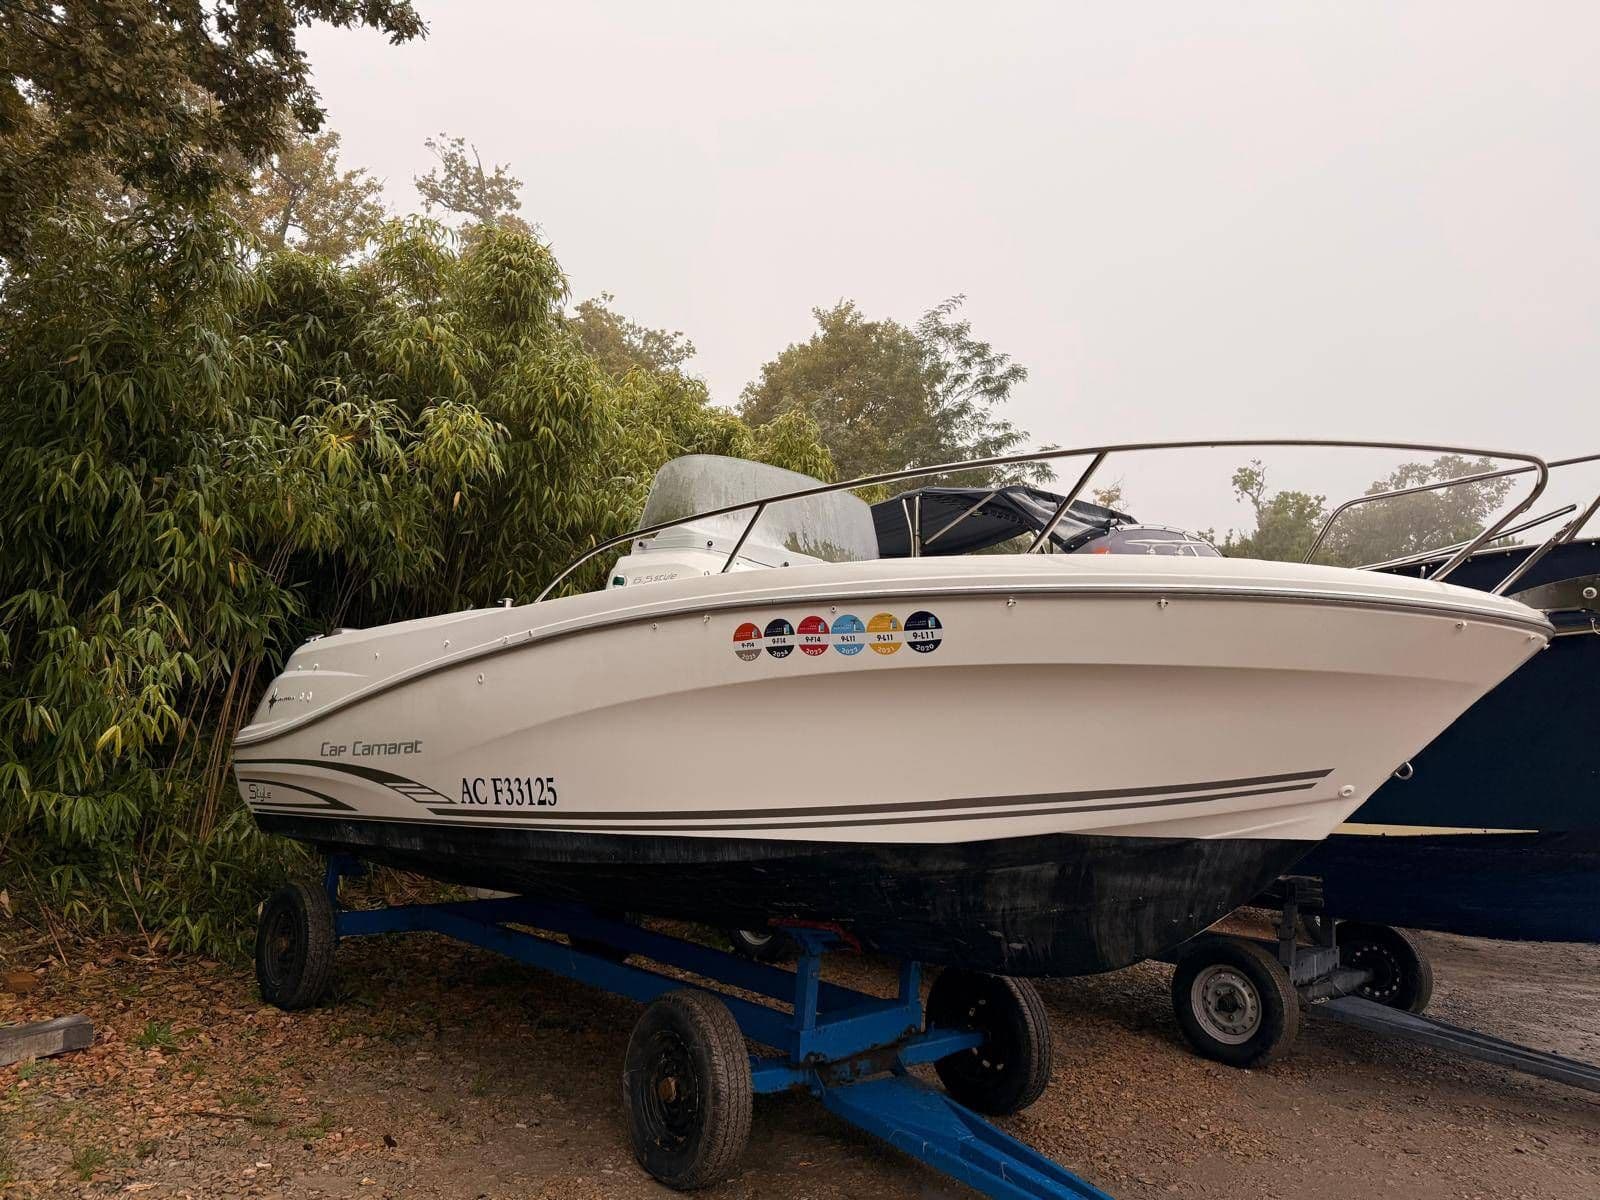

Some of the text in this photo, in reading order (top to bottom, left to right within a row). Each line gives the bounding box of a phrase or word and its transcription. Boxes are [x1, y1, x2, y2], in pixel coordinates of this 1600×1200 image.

[912, 631, 934, 639] 9-L11
[915, 643, 934, 651] 2020
[320, 739, 423, 757] Cap Camarat
[248, 784, 272, 801] Style
[461, 777, 557, 806] AC F33125
